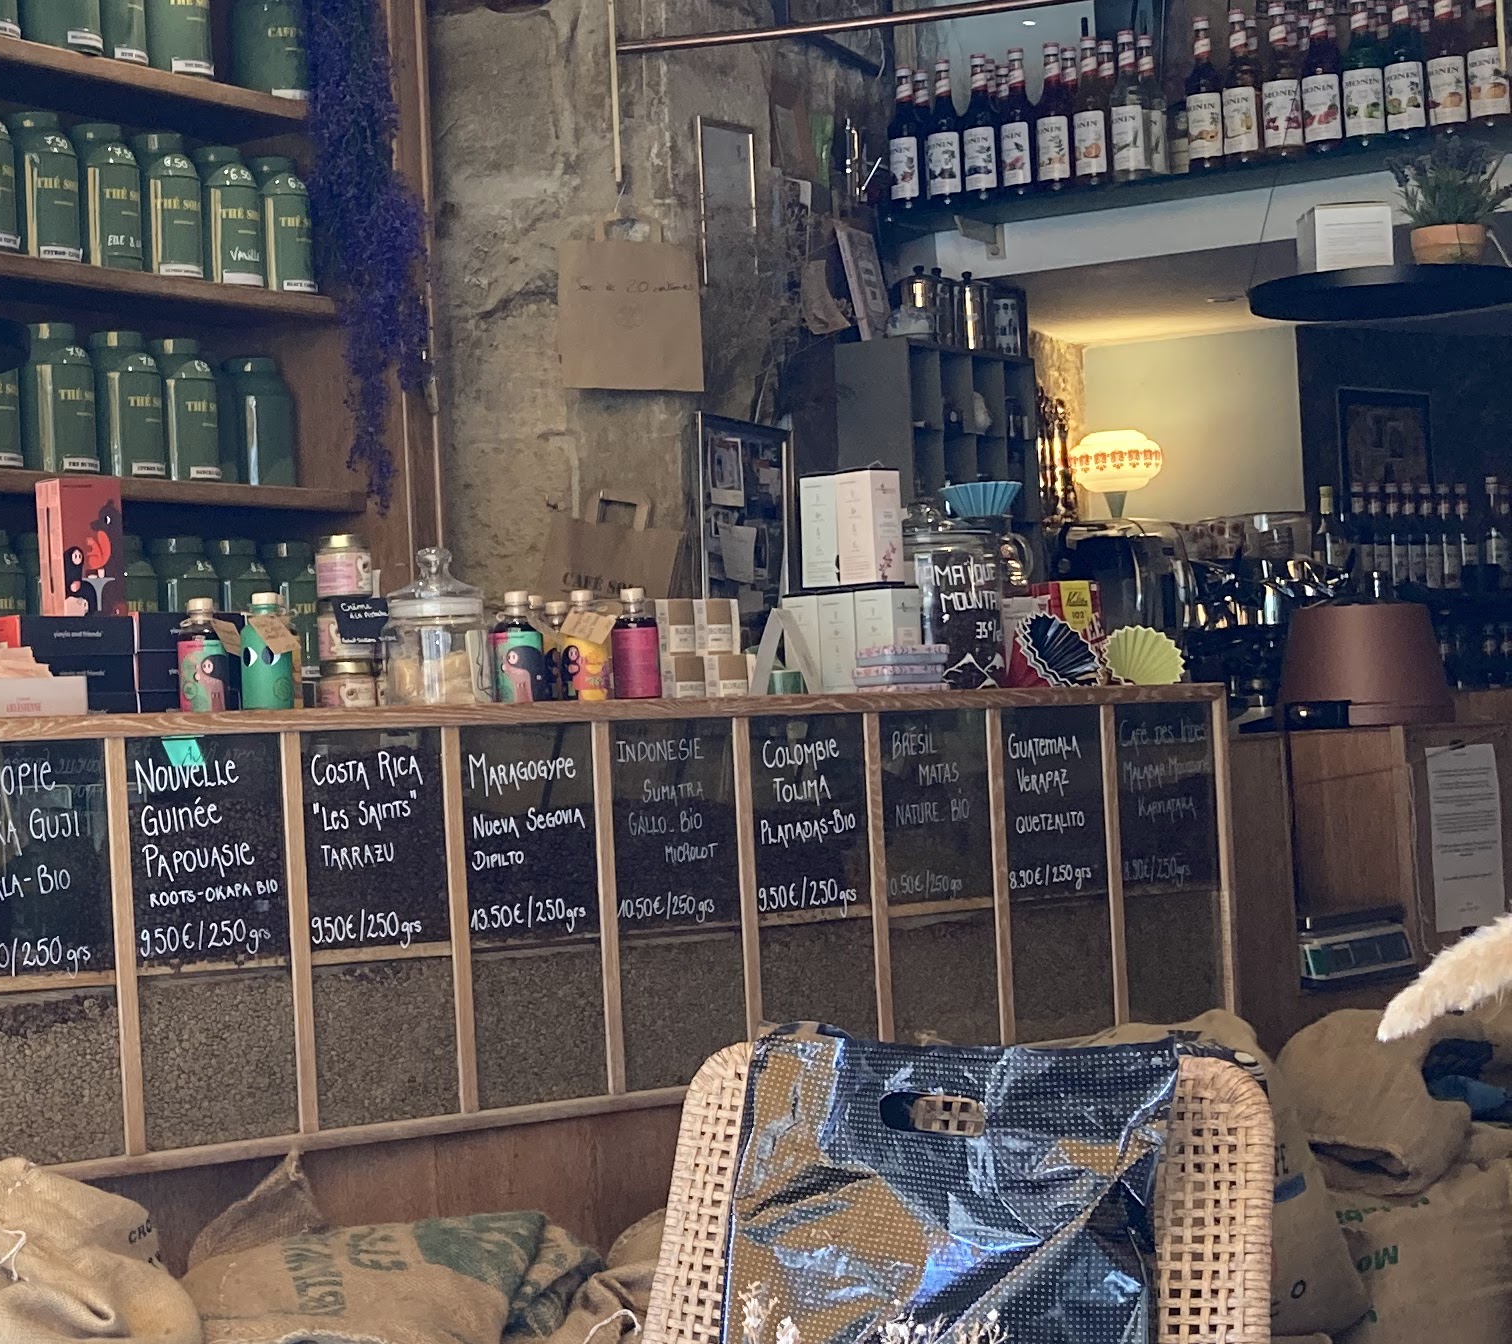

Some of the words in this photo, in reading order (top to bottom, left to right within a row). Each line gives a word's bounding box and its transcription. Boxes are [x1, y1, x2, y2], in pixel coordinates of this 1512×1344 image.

[1344, 77, 1380, 88] MONIN
[57, 387, 84, 401] THÉ
[127, 392, 151, 407] THÉ
[185, 399, 208, 413] THÉ
[561, 571, 605, 593] CAFÉ
[616, 736, 705, 764] INDONESIE
[310, 752, 371, 791] COSTA
[377, 750, 424, 787] RICA
[918, 761, 960, 787] MATAS
[641, 778, 705, 806] SUMATRA
[772, 773, 832, 807] TOLIMA
[29, 807, 80, 842] GUJI
[320, 841, 396, 872] TARRAZU
[471, 849, 525, 872] DIPILTO
[256, 877, 280, 897] BIO
